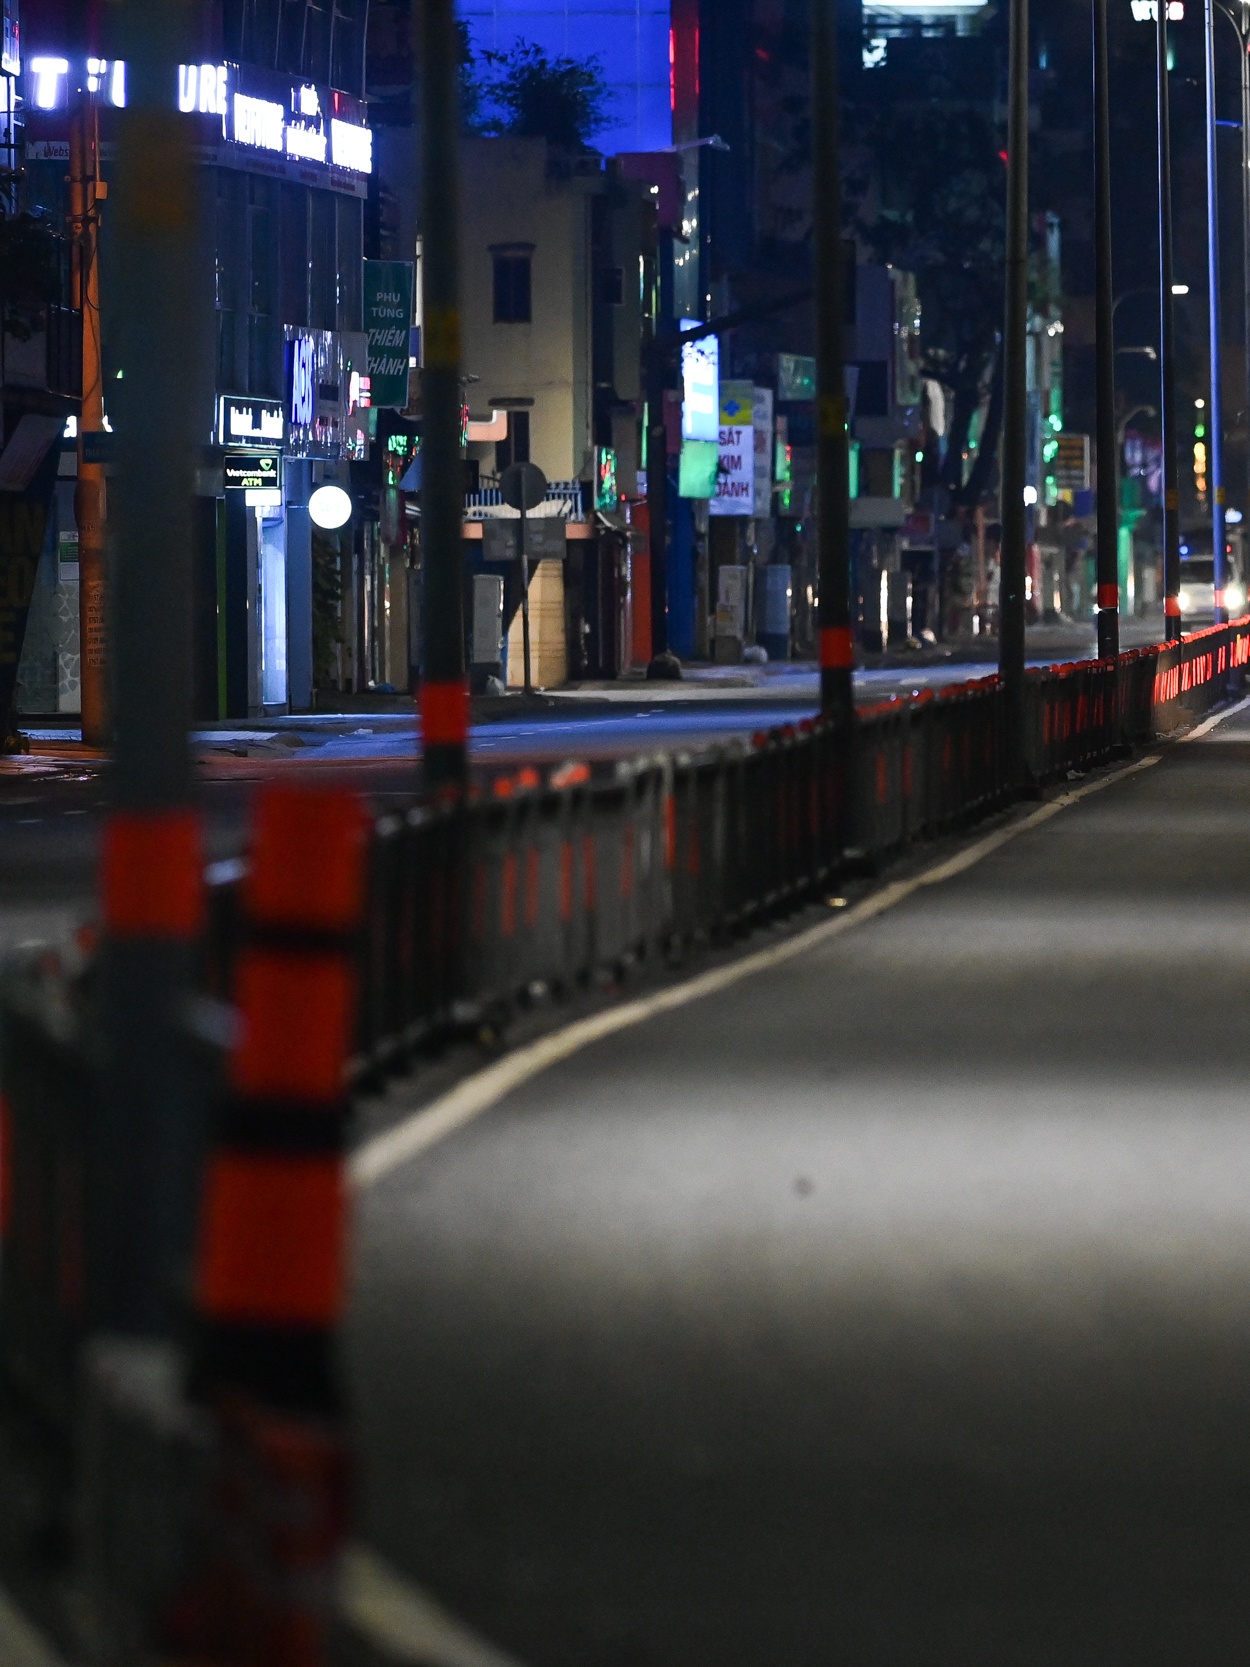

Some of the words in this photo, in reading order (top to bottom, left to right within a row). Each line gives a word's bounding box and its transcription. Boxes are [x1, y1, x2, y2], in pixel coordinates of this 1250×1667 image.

[376, 292, 401, 306] PHỤ
[371, 306, 404, 318] TÙNG
[719, 427, 742, 446] SẮT
[241, 477, 263, 486] ATM
